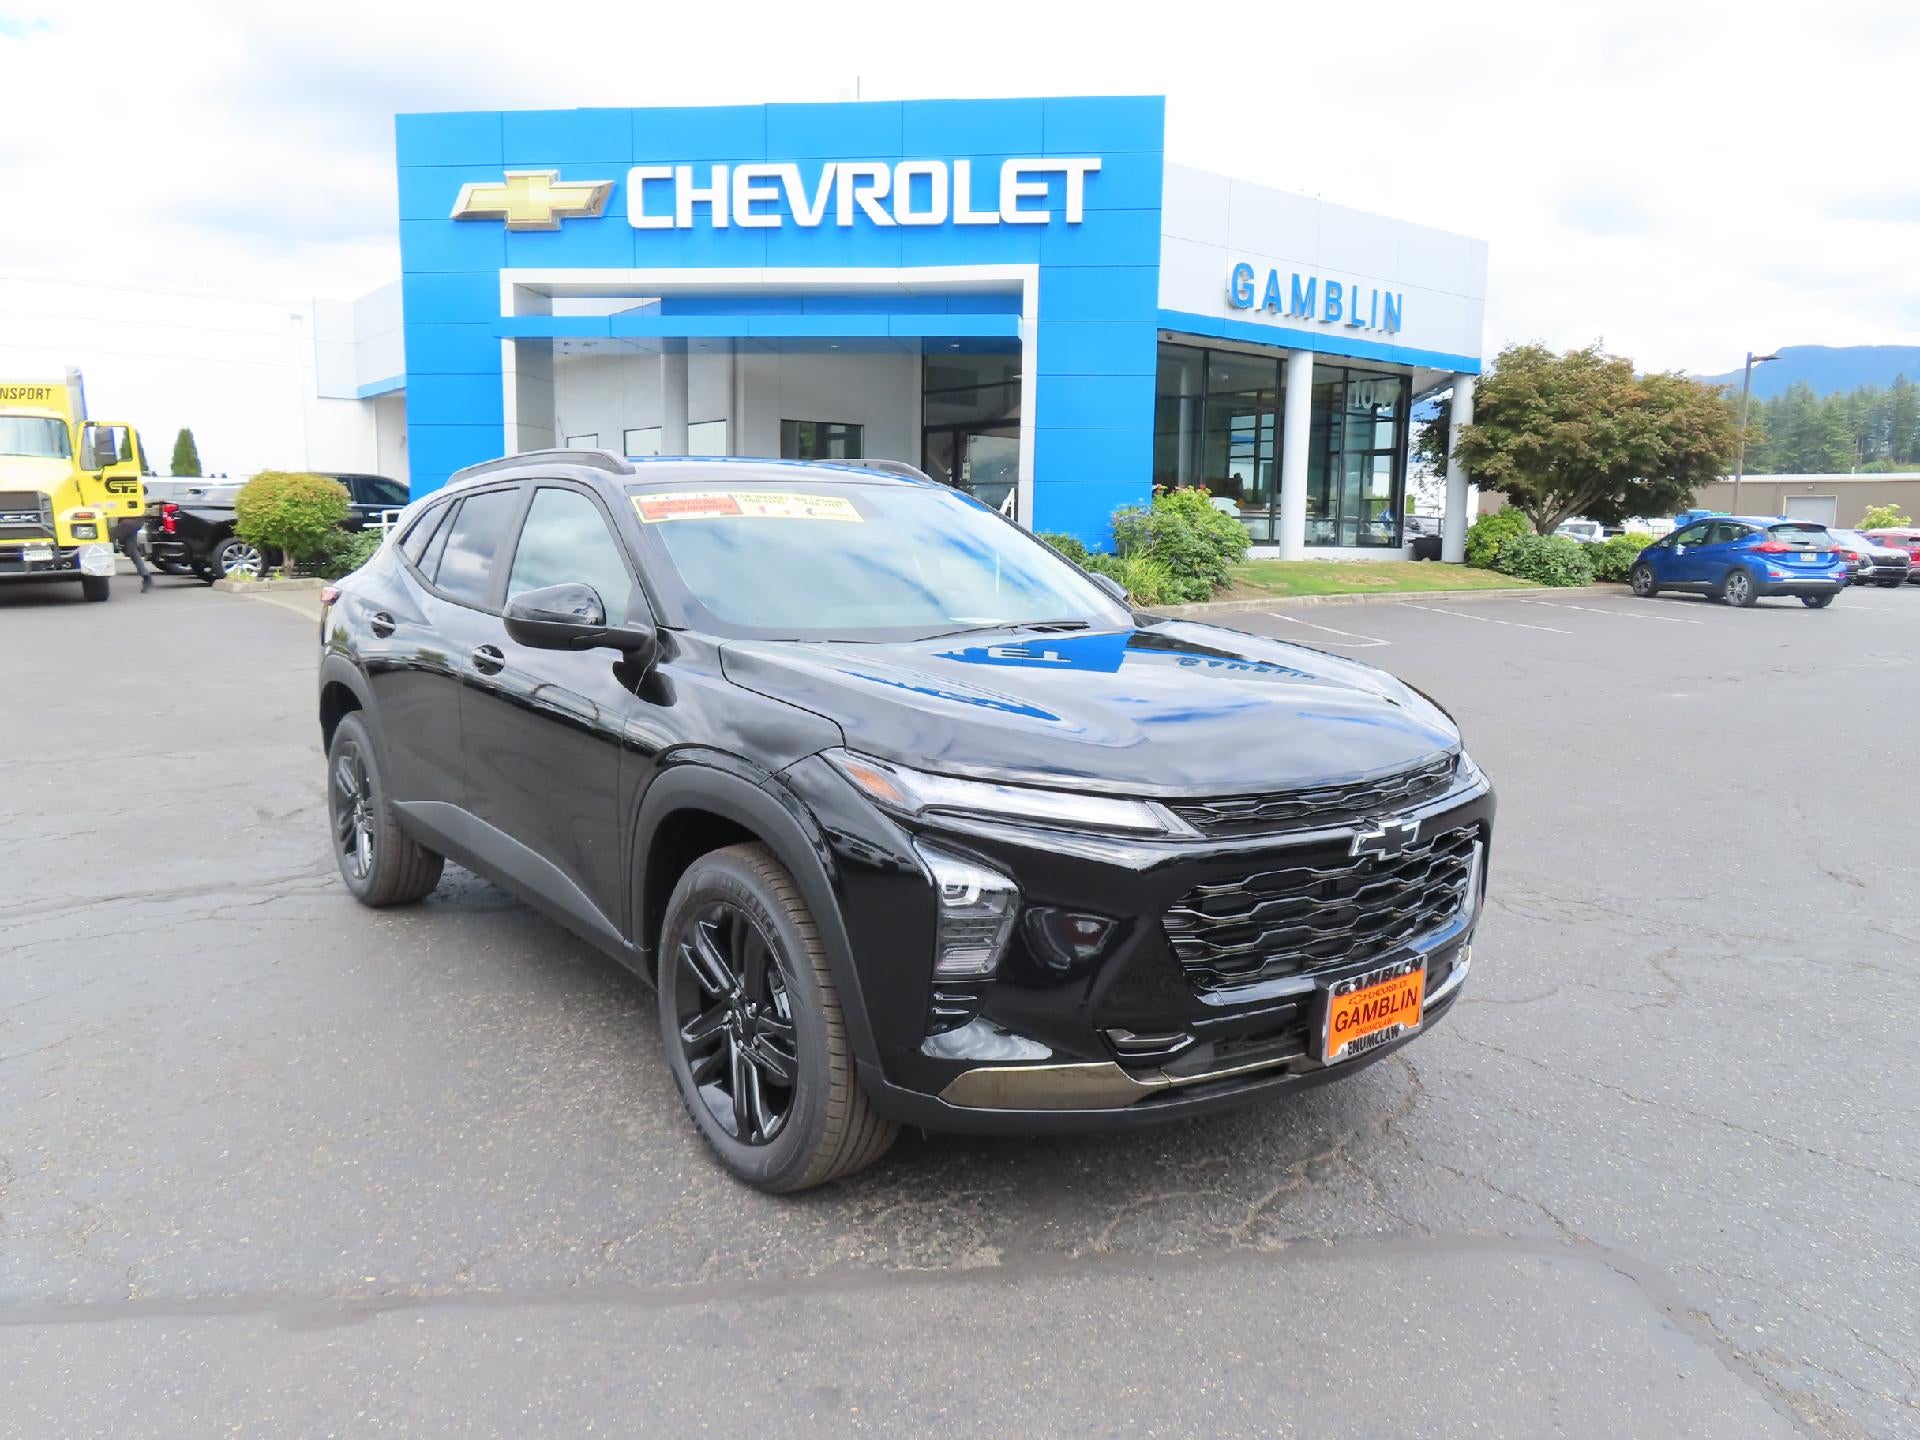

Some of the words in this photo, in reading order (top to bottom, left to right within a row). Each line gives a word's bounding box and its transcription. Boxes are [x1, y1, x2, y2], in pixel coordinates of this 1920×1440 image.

[627, 158, 1101, 228] CHEVROLET
[1231, 262, 1402, 333] GAMBLIN
[1334, 986, 1418, 1033] GAMBLIN
[1347, 1024, 1400, 1056] ENUMCLAW
